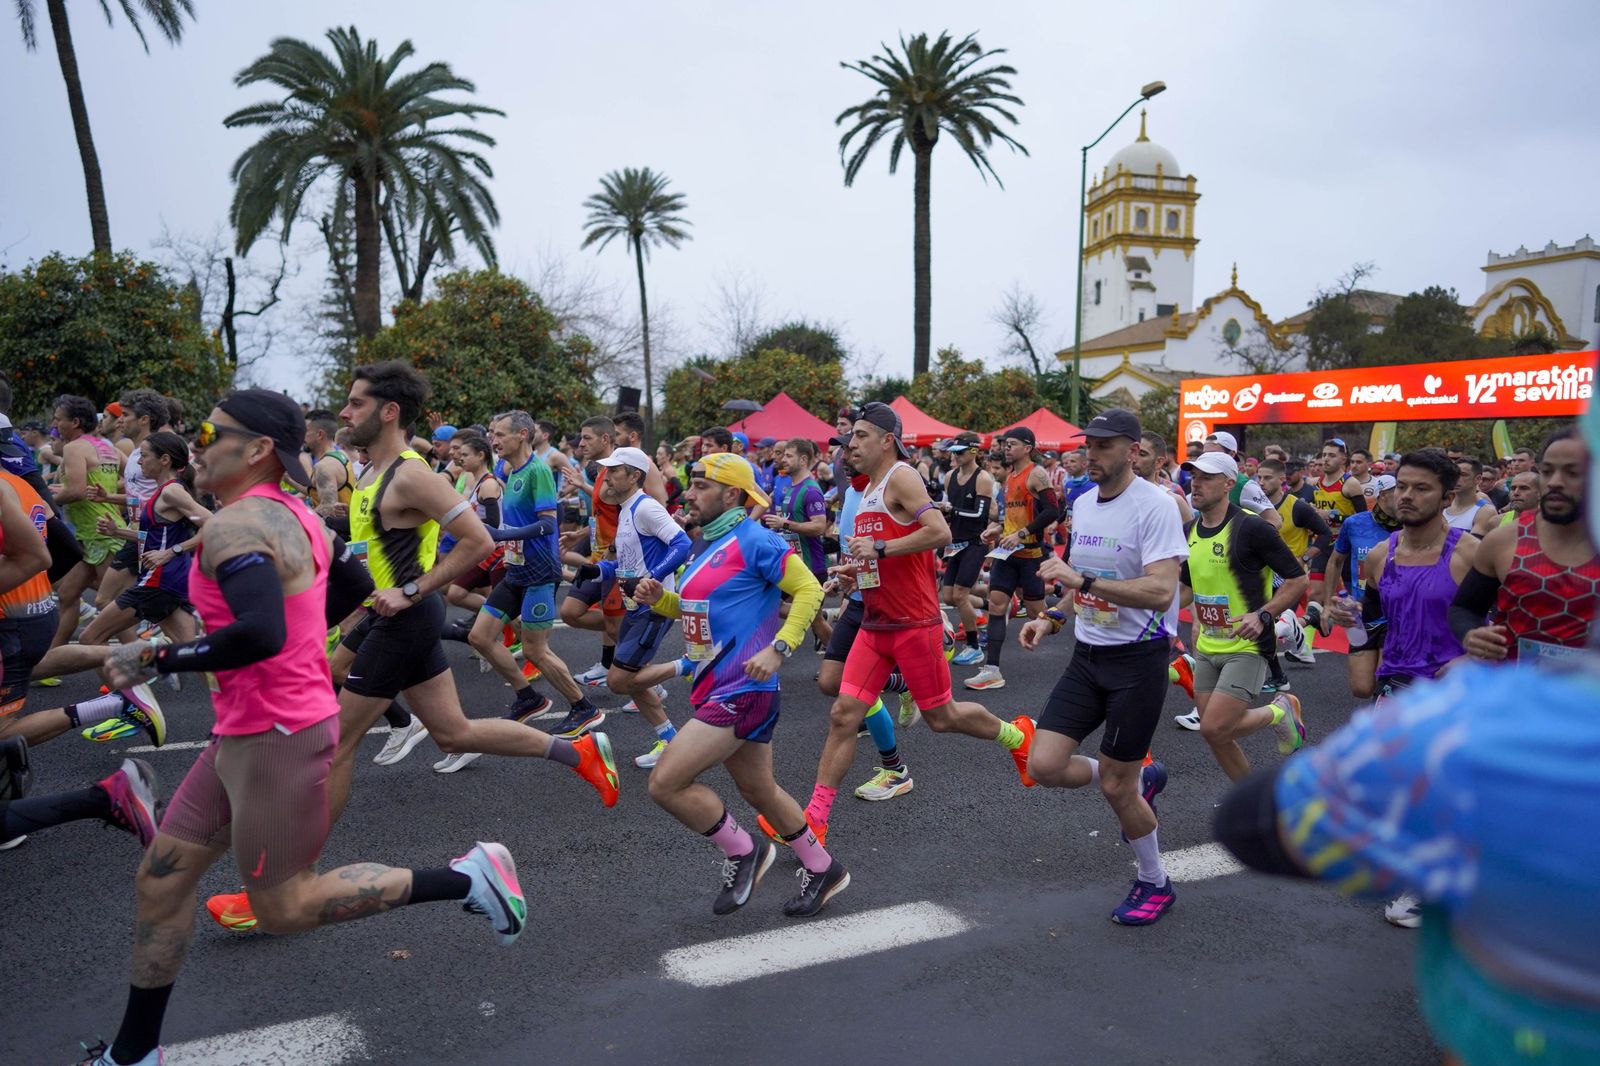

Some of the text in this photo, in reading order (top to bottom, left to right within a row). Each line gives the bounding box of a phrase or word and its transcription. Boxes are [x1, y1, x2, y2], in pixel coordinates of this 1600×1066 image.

[1491, 364, 1593, 388] maratón
[1350, 384, 1404, 404] HOKA
[1513, 382, 1593, 402] sevilla
[1077, 535, 1118, 550] STARTFIT
[1200, 605, 1220, 621] 243
